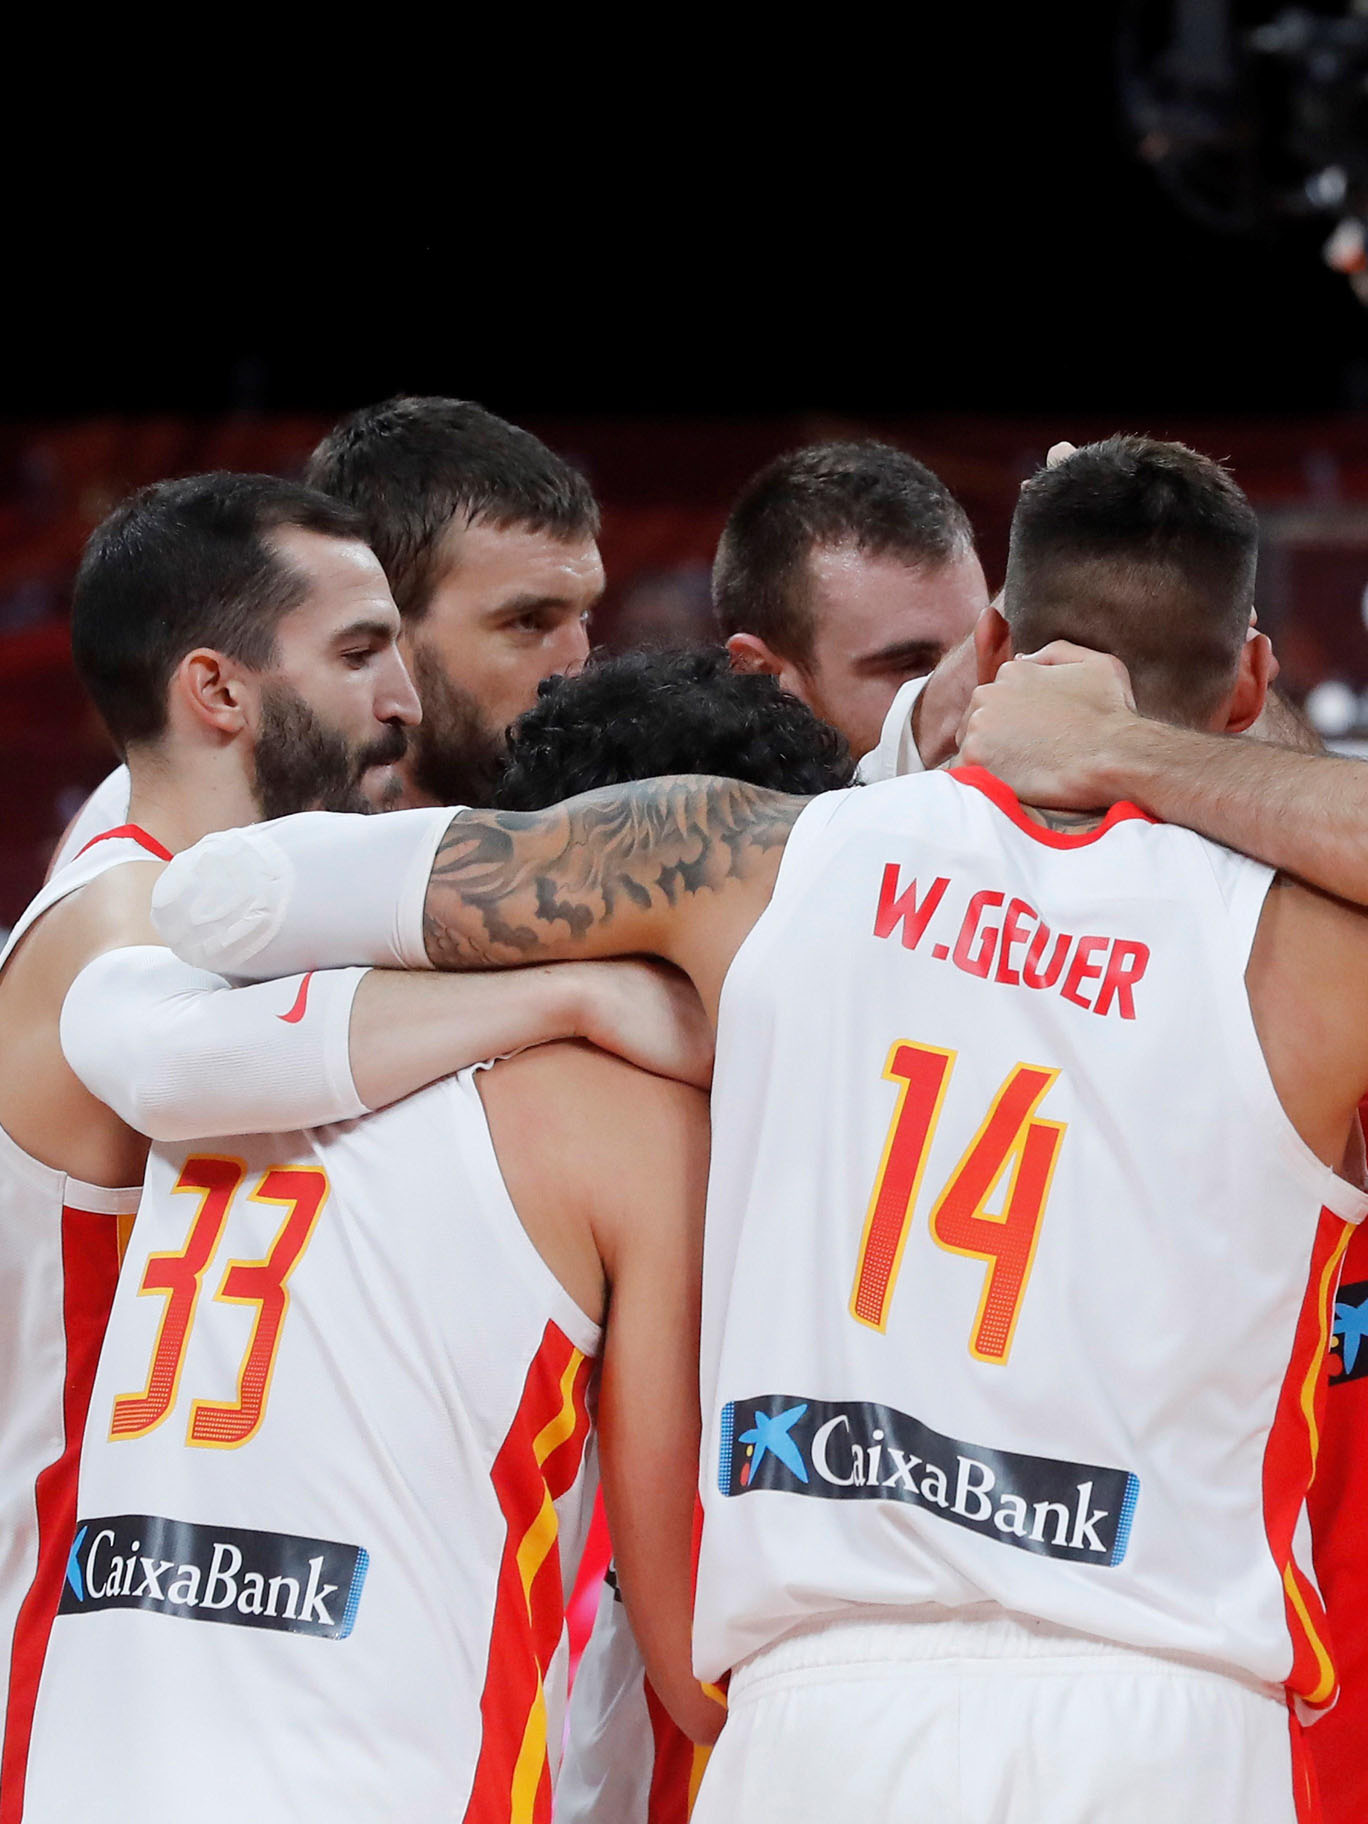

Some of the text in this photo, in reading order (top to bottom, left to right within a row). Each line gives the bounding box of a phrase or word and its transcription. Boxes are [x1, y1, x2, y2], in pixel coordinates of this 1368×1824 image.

[873, 862, 1151, 1020] W.GEUER
[848, 1038, 1069, 1366] 14
[107, 1154, 330, 1449] 33
[811, 1414, 1109, 1554] CaixaBank
[85, 1529, 341, 1626] CaixaBank
